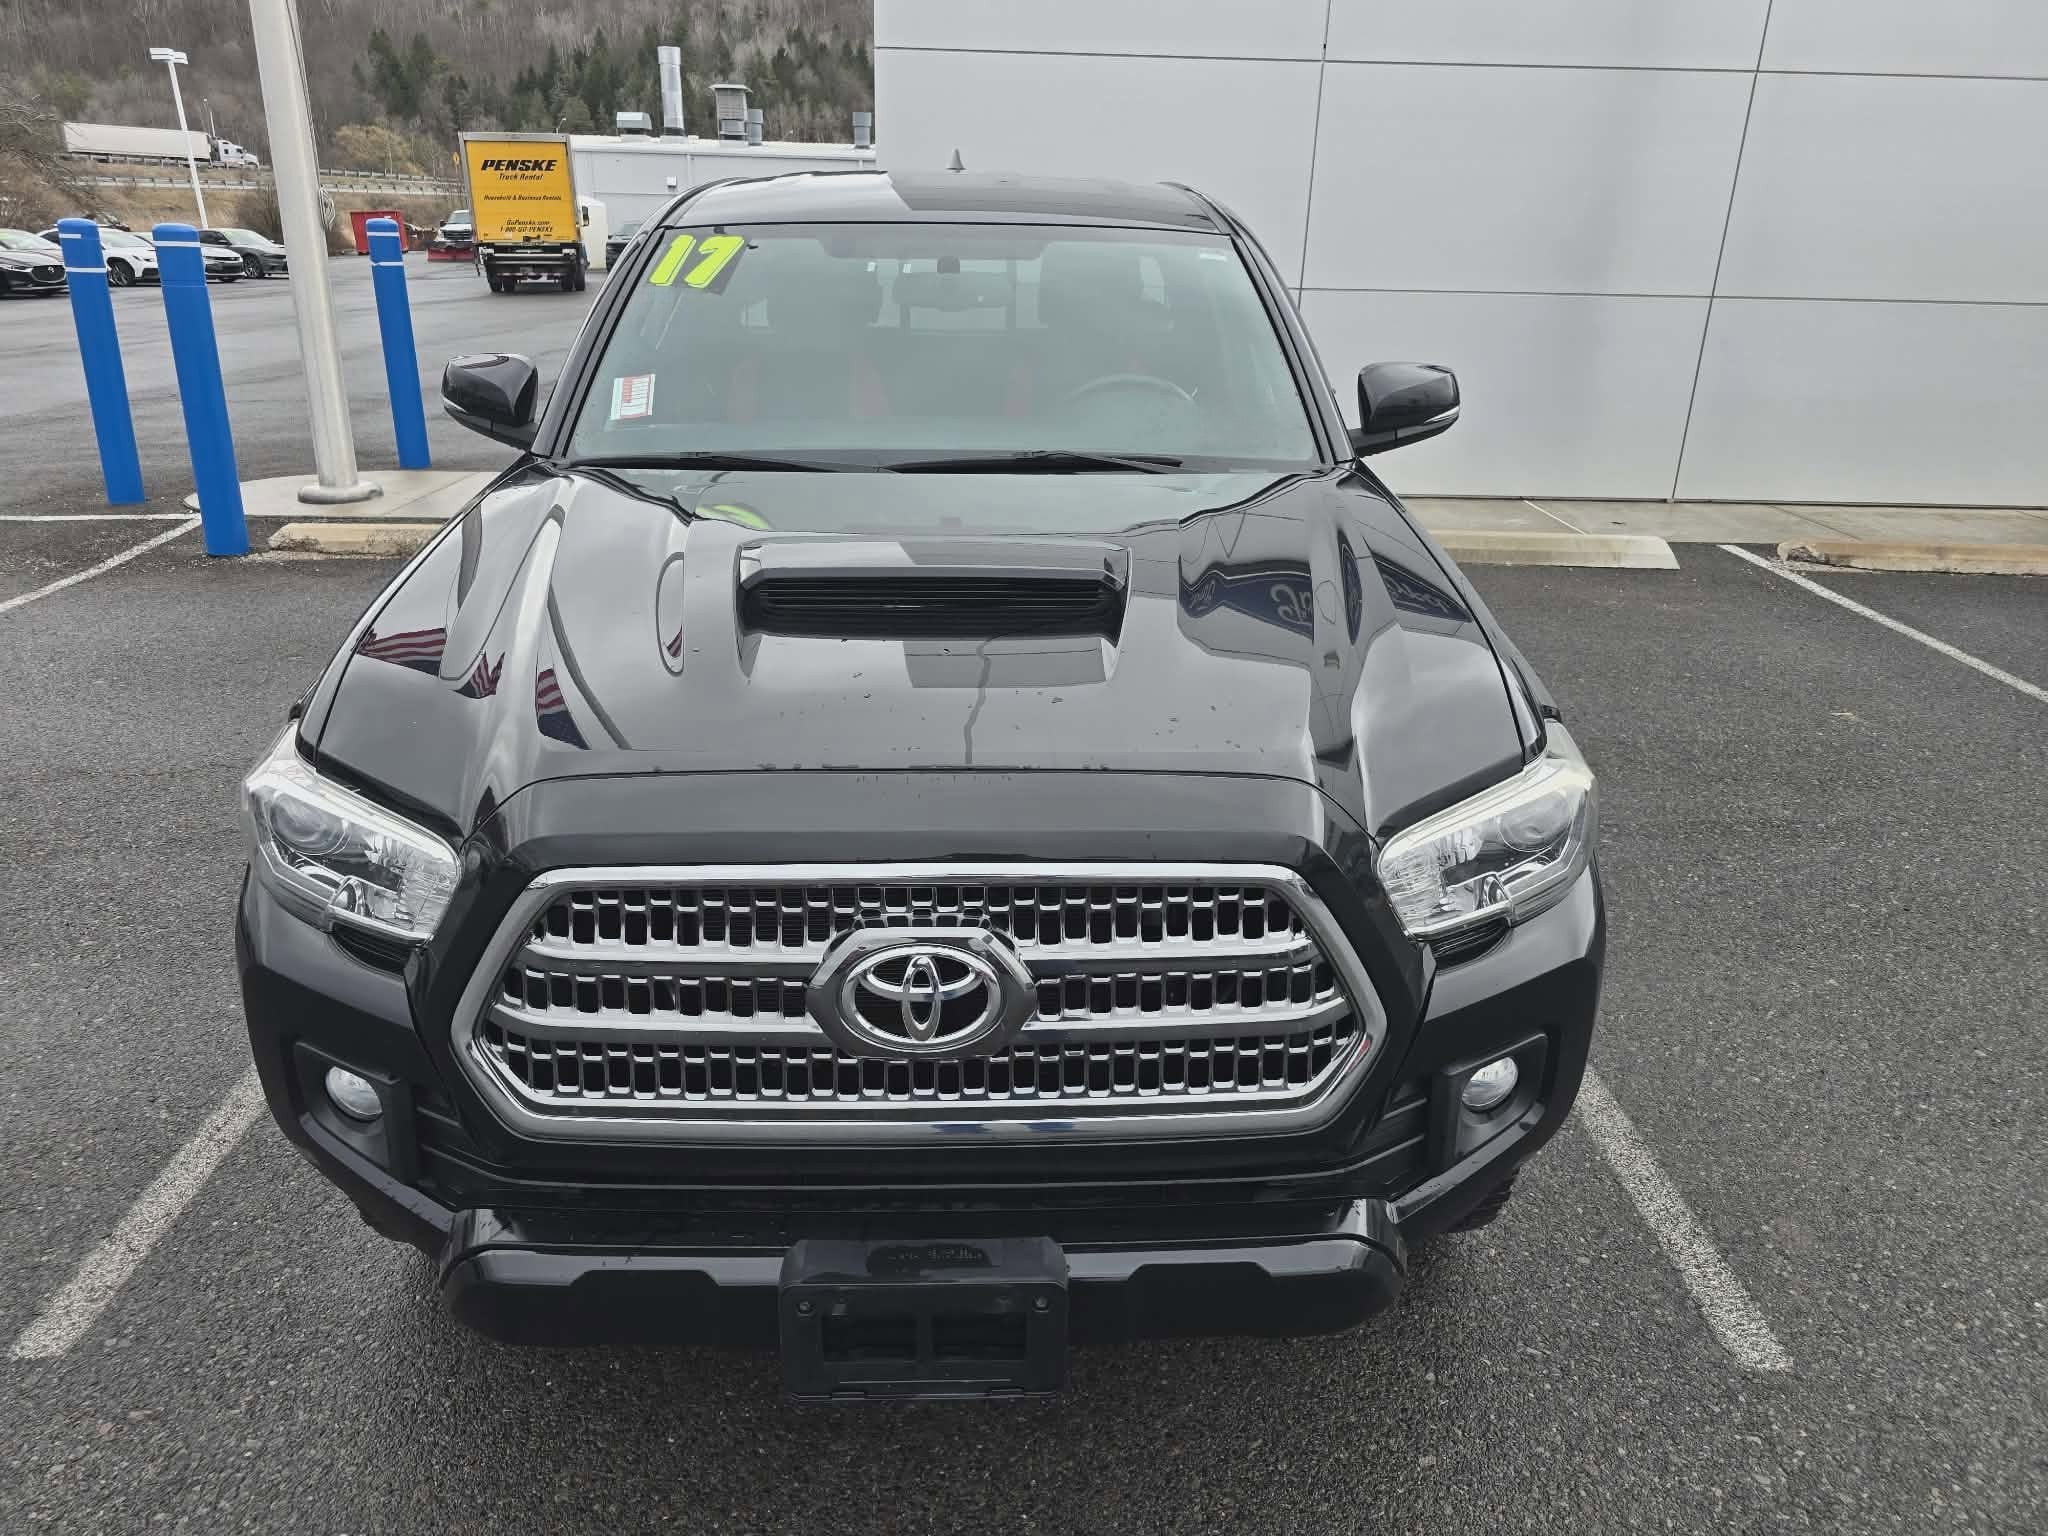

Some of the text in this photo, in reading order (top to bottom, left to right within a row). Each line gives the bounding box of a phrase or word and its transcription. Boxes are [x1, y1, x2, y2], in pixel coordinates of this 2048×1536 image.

[481, 159, 558, 172] PENSKE
[499, 173, 544, 181] Truck Rental
[649, 234, 745, 288] 17
